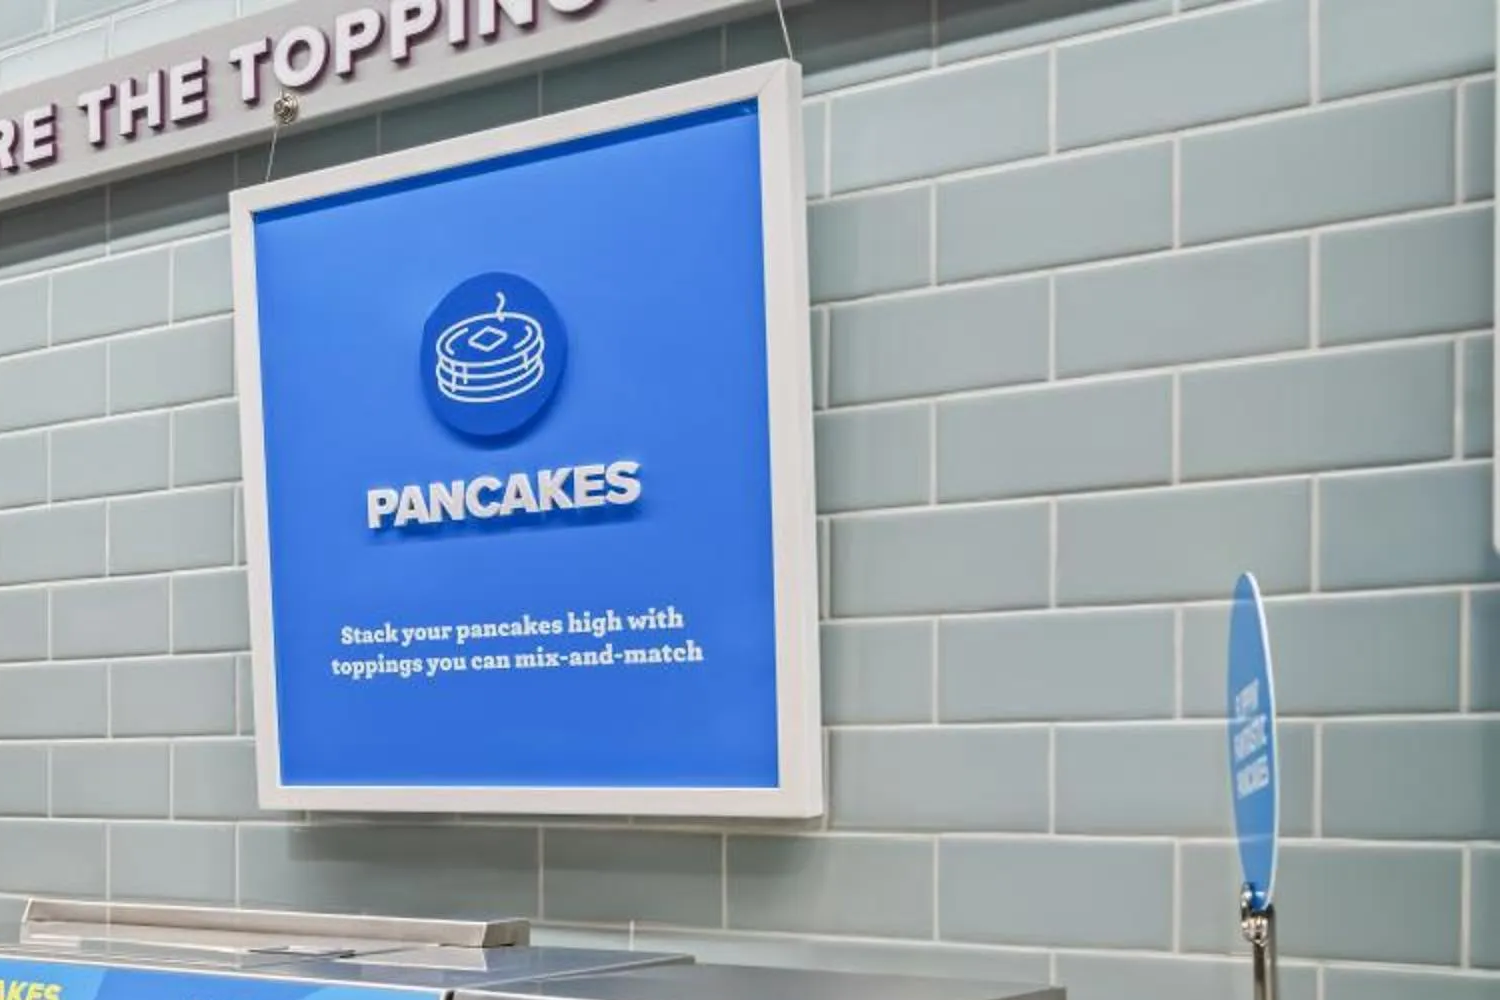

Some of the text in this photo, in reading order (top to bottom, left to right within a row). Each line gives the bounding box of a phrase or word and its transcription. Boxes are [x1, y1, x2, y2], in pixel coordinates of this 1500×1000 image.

[78, 57, 207, 147] THE
[230, 0, 597, 102] TOPPI
[367, 460, 642, 528] PANCAKES
[341, 605, 684, 647] Stack your pancakes high with
[331, 640, 704, 680] toppings you can mix-and-match
